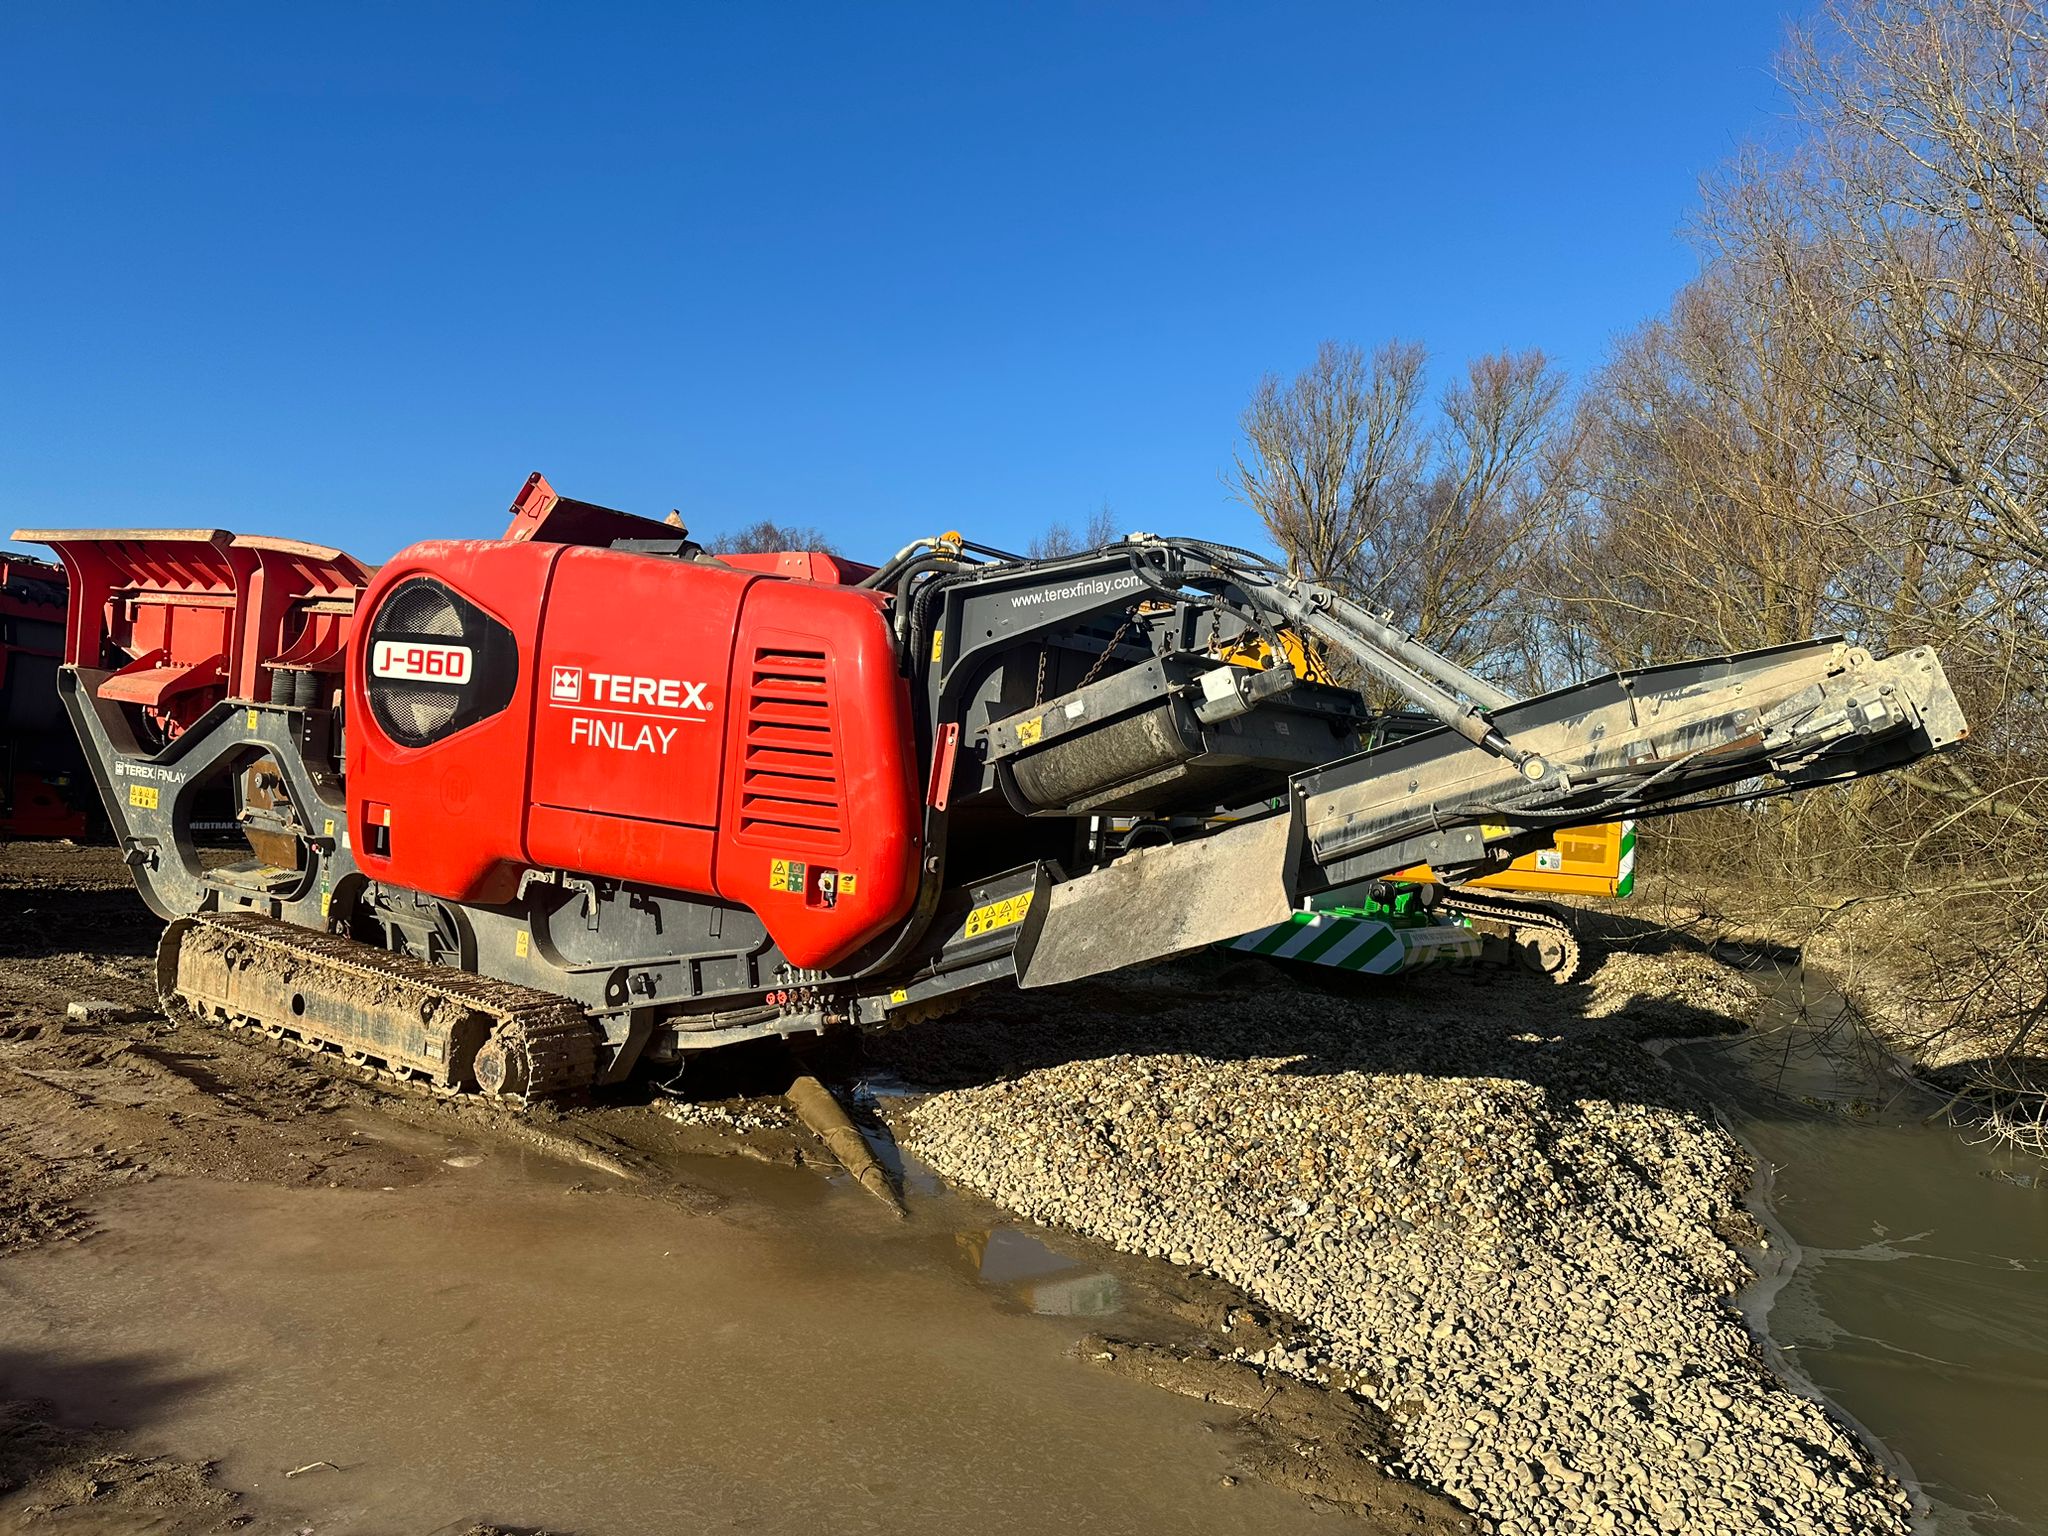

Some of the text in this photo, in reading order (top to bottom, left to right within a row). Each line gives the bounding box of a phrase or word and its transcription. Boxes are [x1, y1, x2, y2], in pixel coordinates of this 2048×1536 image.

[1011, 575, 1143, 608] www.terexfinlay.com
[380, 647, 465, 677] J-960
[571, 718, 678, 754] FINLAY
[124, 764, 187, 783] TEREX FINLAY
